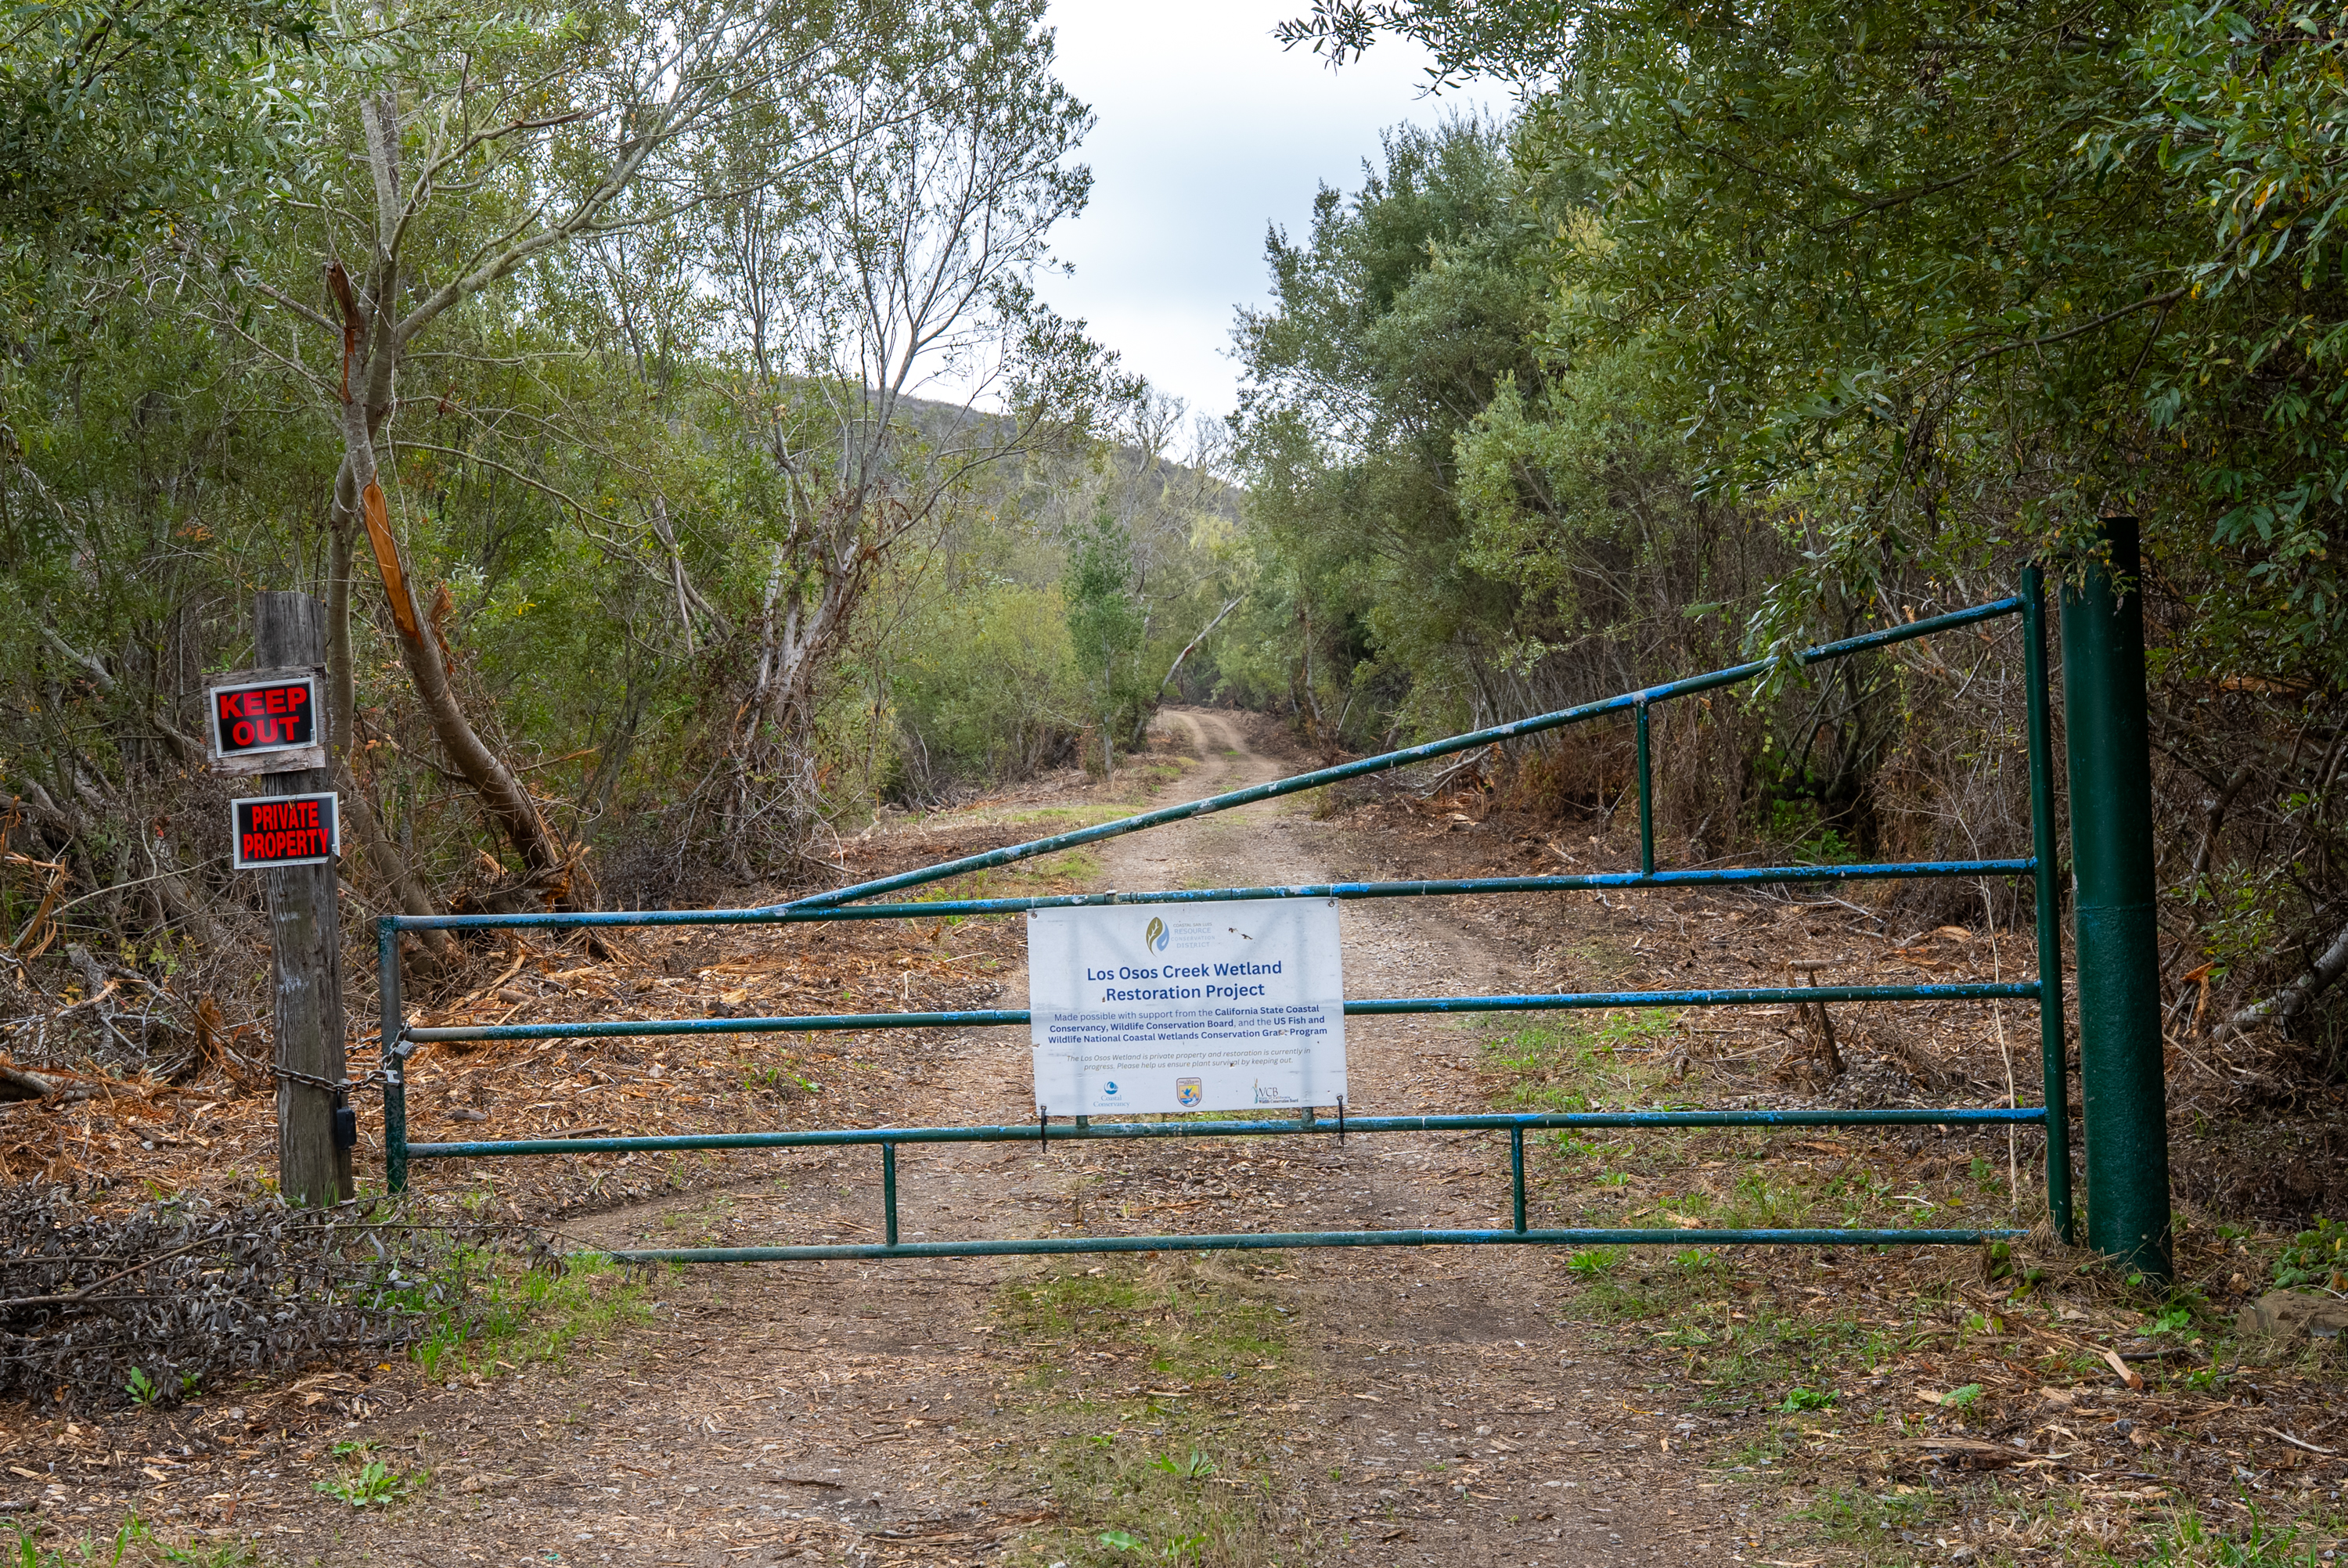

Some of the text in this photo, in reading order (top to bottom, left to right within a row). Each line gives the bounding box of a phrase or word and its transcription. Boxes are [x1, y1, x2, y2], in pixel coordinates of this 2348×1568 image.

[220, 687, 307, 719] KEEP
[232, 716, 300, 746] OUT
[252, 801, 319, 831] PRIVATE
[243, 828, 329, 859] PROPERTY
[1087, 961, 1282, 980] Los Osos Creek Wetland
[1107, 984, 1265, 1001] Restoration Project
[1080, 1012, 1116, 1022] possible
[1139, 1010, 1173, 1020] support
[1176, 1009, 1196, 1018] from
[1198, 1009, 1213, 1017] the
[1215, 1007, 1259, 1016] California
[1286, 1005, 1320, 1013] Coastal
[1050, 1016, 1325, 1033] Conservancy, Wildlife Conservation Board, and the US Fish and
[1048, 1035, 1082, 1044] Wildlife
[1083, 1034, 1121, 1043] National
[1122, 1033, 1156, 1041] Coastal
[1158, 1031, 1199, 1041] Wetlands
[1201, 1030, 1260, 1039] Conservation
[1290, 1028, 1327, 1037] Program
[1149, 1052, 1174, 1061] private
[1176, 1052, 1206, 1060] property
